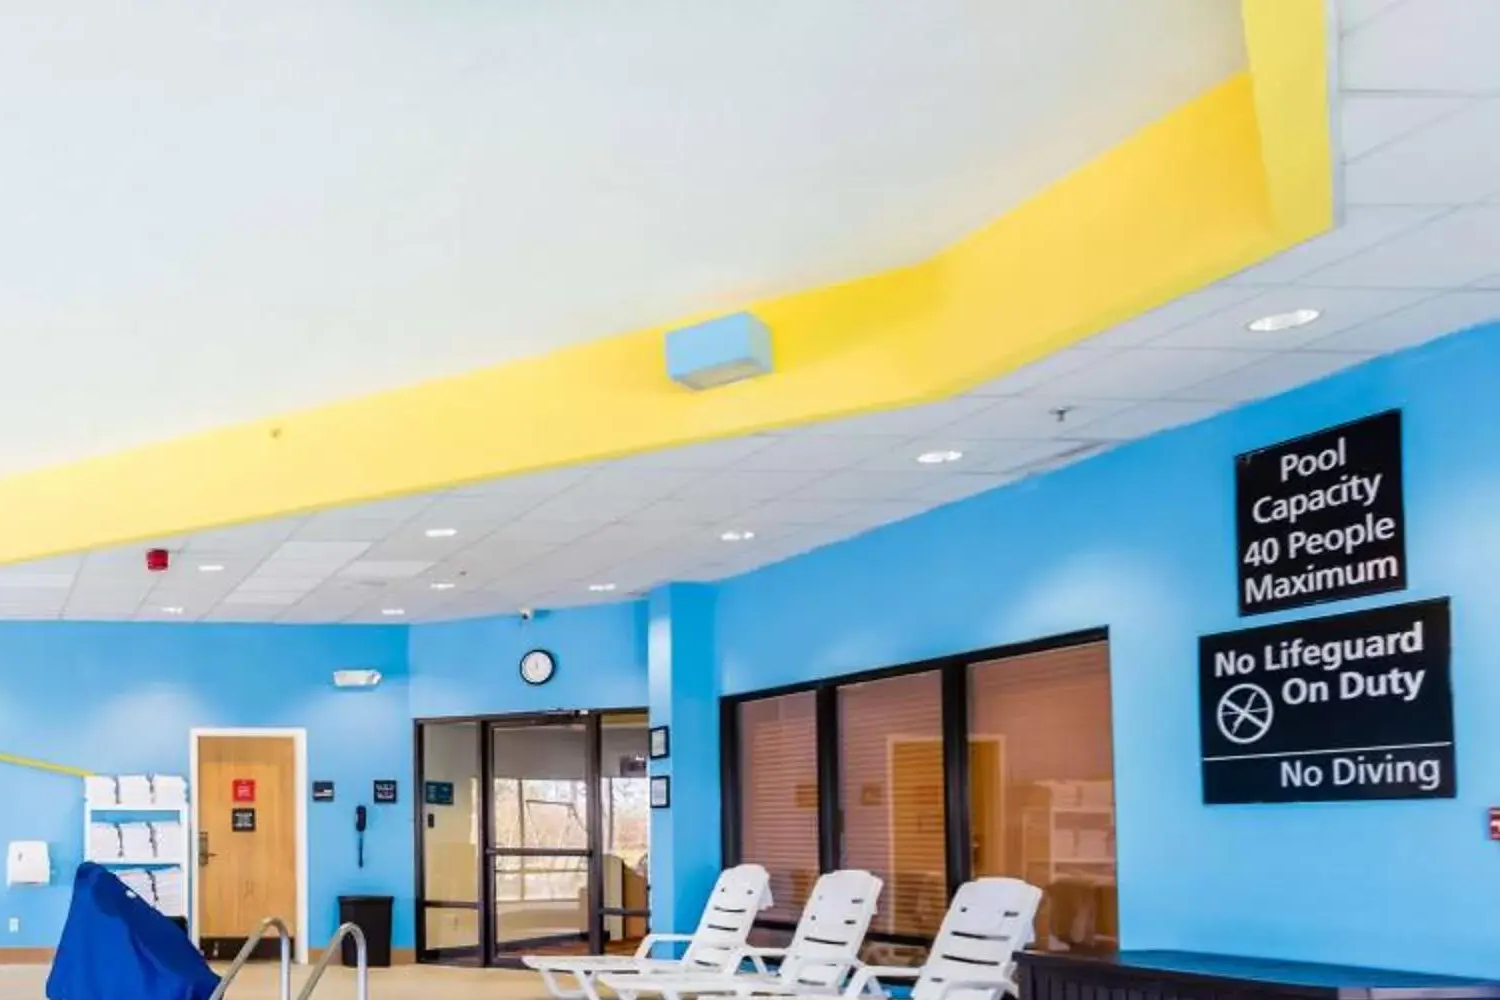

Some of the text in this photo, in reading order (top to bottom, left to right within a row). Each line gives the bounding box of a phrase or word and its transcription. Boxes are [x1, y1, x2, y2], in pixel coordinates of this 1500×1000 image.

[1280, 437, 1346, 482] Pool
[1252, 474, 1382, 523] Capacity
[1243, 513, 1396, 567] 40 People
[1244, 555, 1398, 604] Maximum
[1214, 621, 1424, 677] No Lifeguard
[1282, 668, 1426, 705] On Duty
[1280, 754, 1441, 790] No Diving
